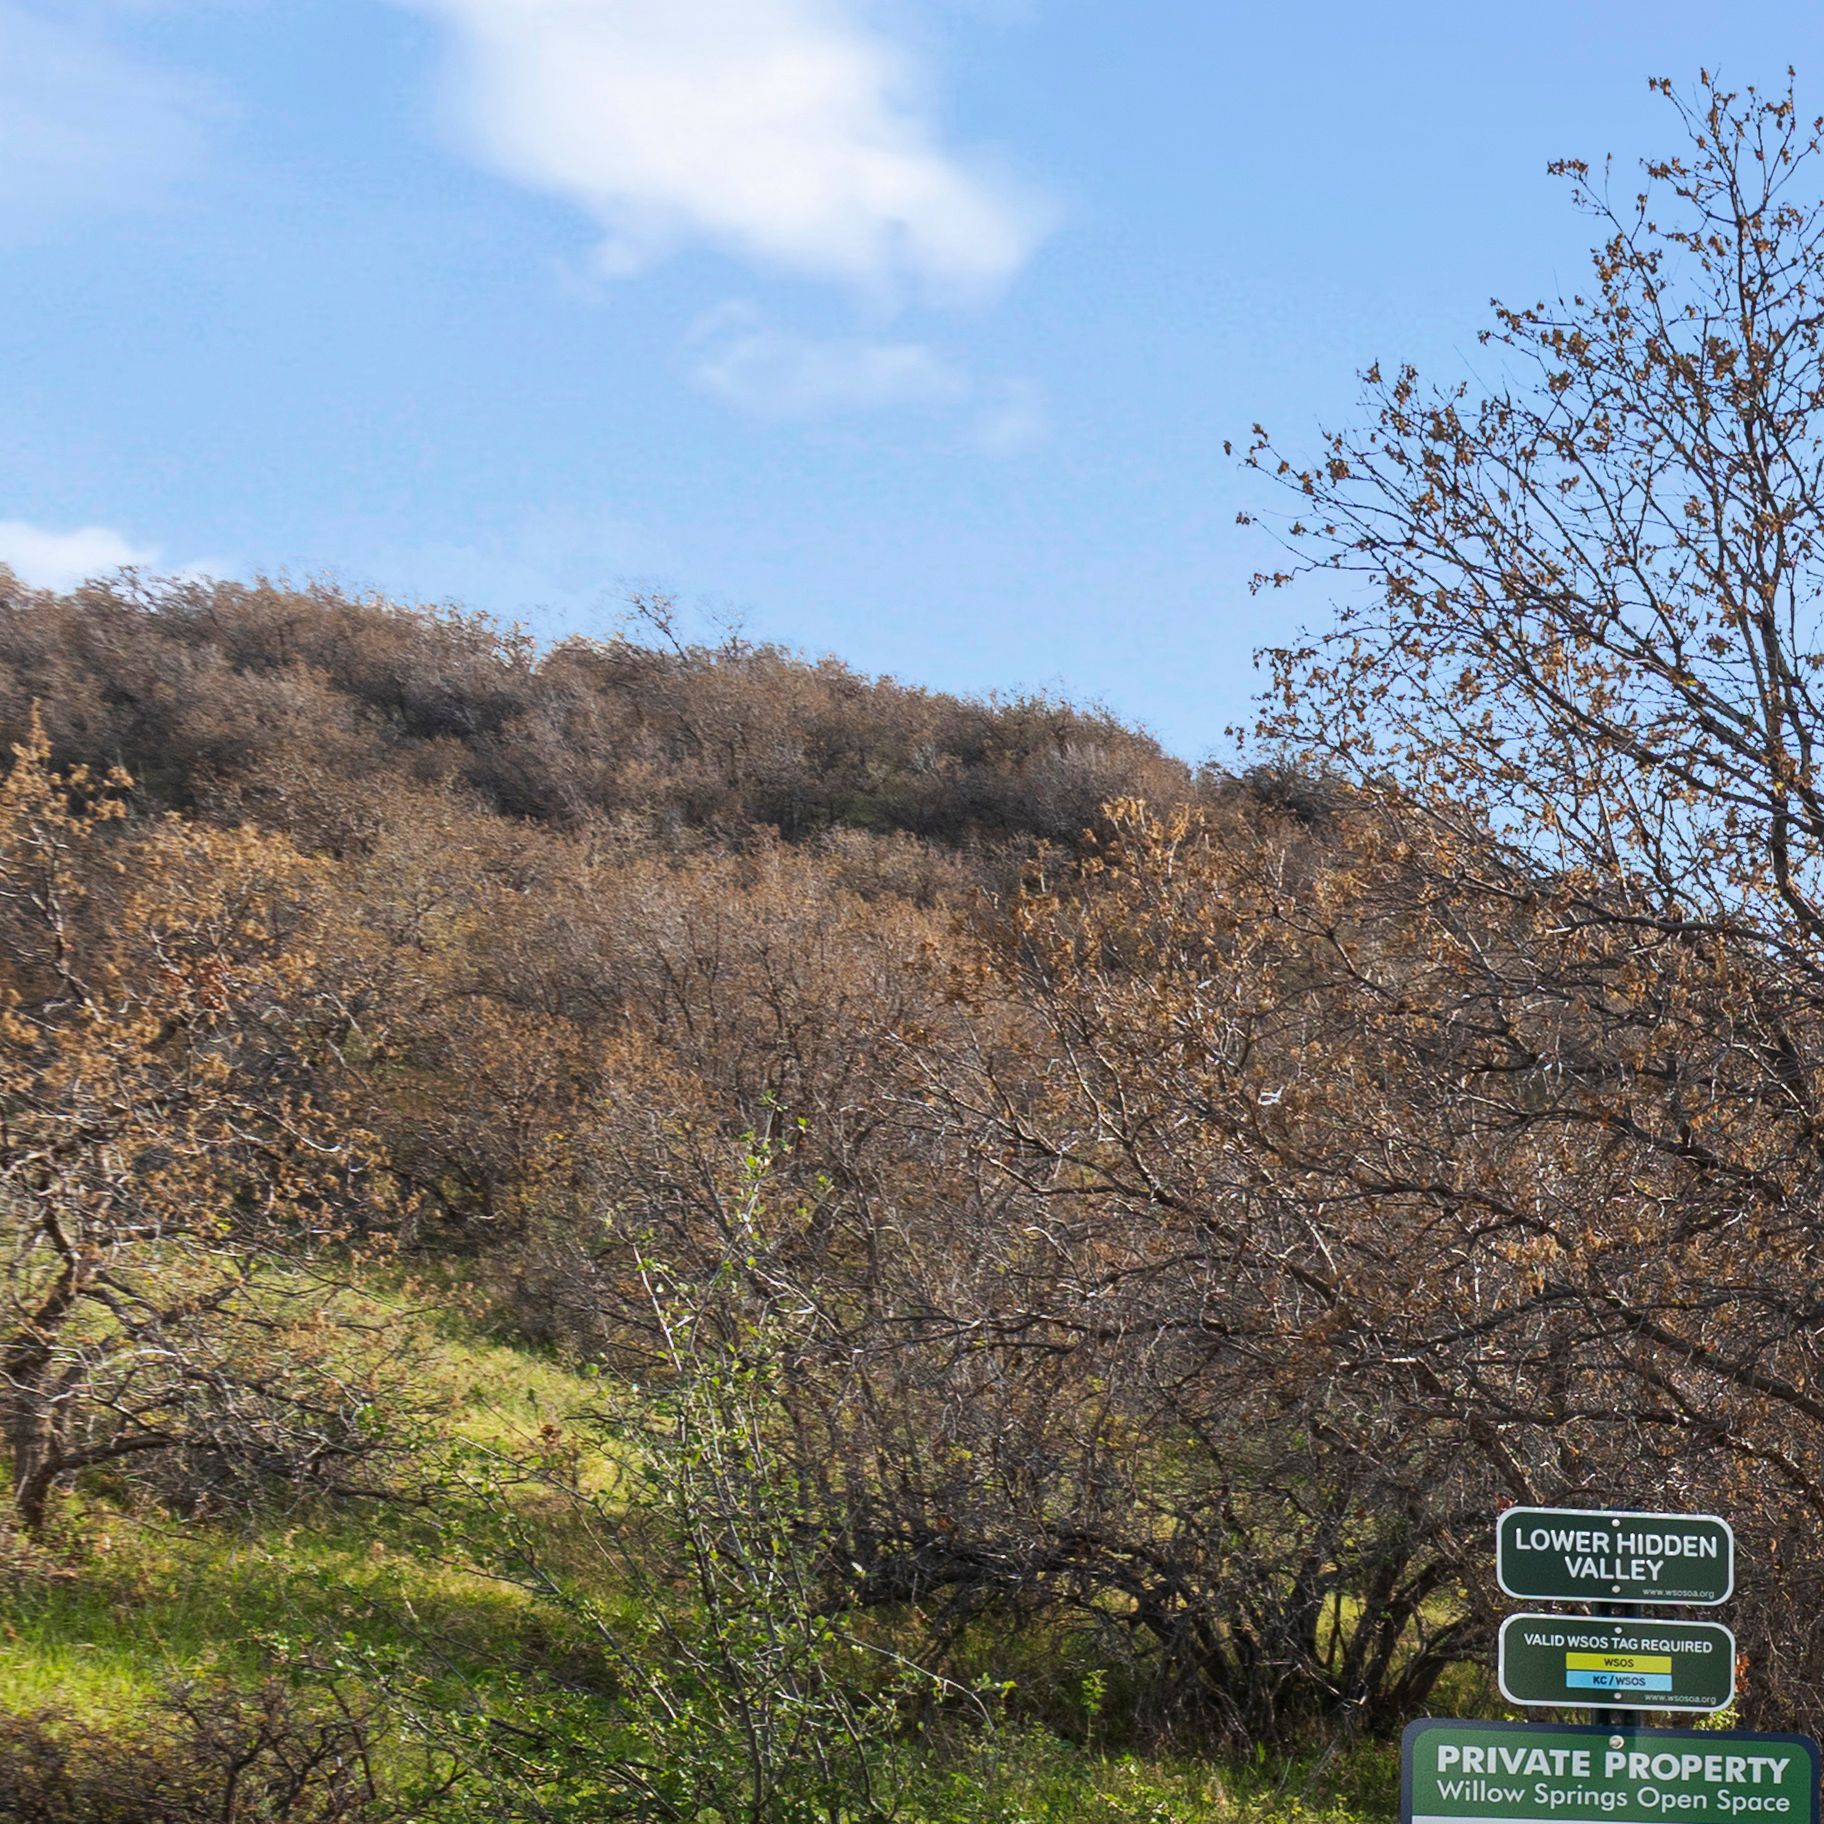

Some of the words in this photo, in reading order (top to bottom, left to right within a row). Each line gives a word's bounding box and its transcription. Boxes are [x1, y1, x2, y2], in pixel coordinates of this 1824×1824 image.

[1516, 1528, 1610, 1553] LOWER
[1617, 1533, 1717, 1558] HIDDEN
[1565, 1556, 1664, 1581] VALLEY
[1642, 1588, 1714, 1599] www.wsosoa.org
[1524, 1633, 1565, 1646] VALID
[1567, 1636, 1608, 1649] WSOS
[1611, 1637, 1638, 1650] TAG
[1641, 1639, 1712, 1653] REQUIRED
[1604, 1658, 1634, 1667] WSOS
[1645, 1693, 1716, 1704] www.wsosoa.org
[1437, 1745, 1591, 1778] PRIVATE
[1604, 1751, 1790, 1784] PROPERTY
[1436, 1779, 1526, 1803] Willow
[1534, 1783, 1628, 1811] Springs
[1636, 1786, 1708, 1813] Open
[1716, 1790, 1790, 1815] Space
